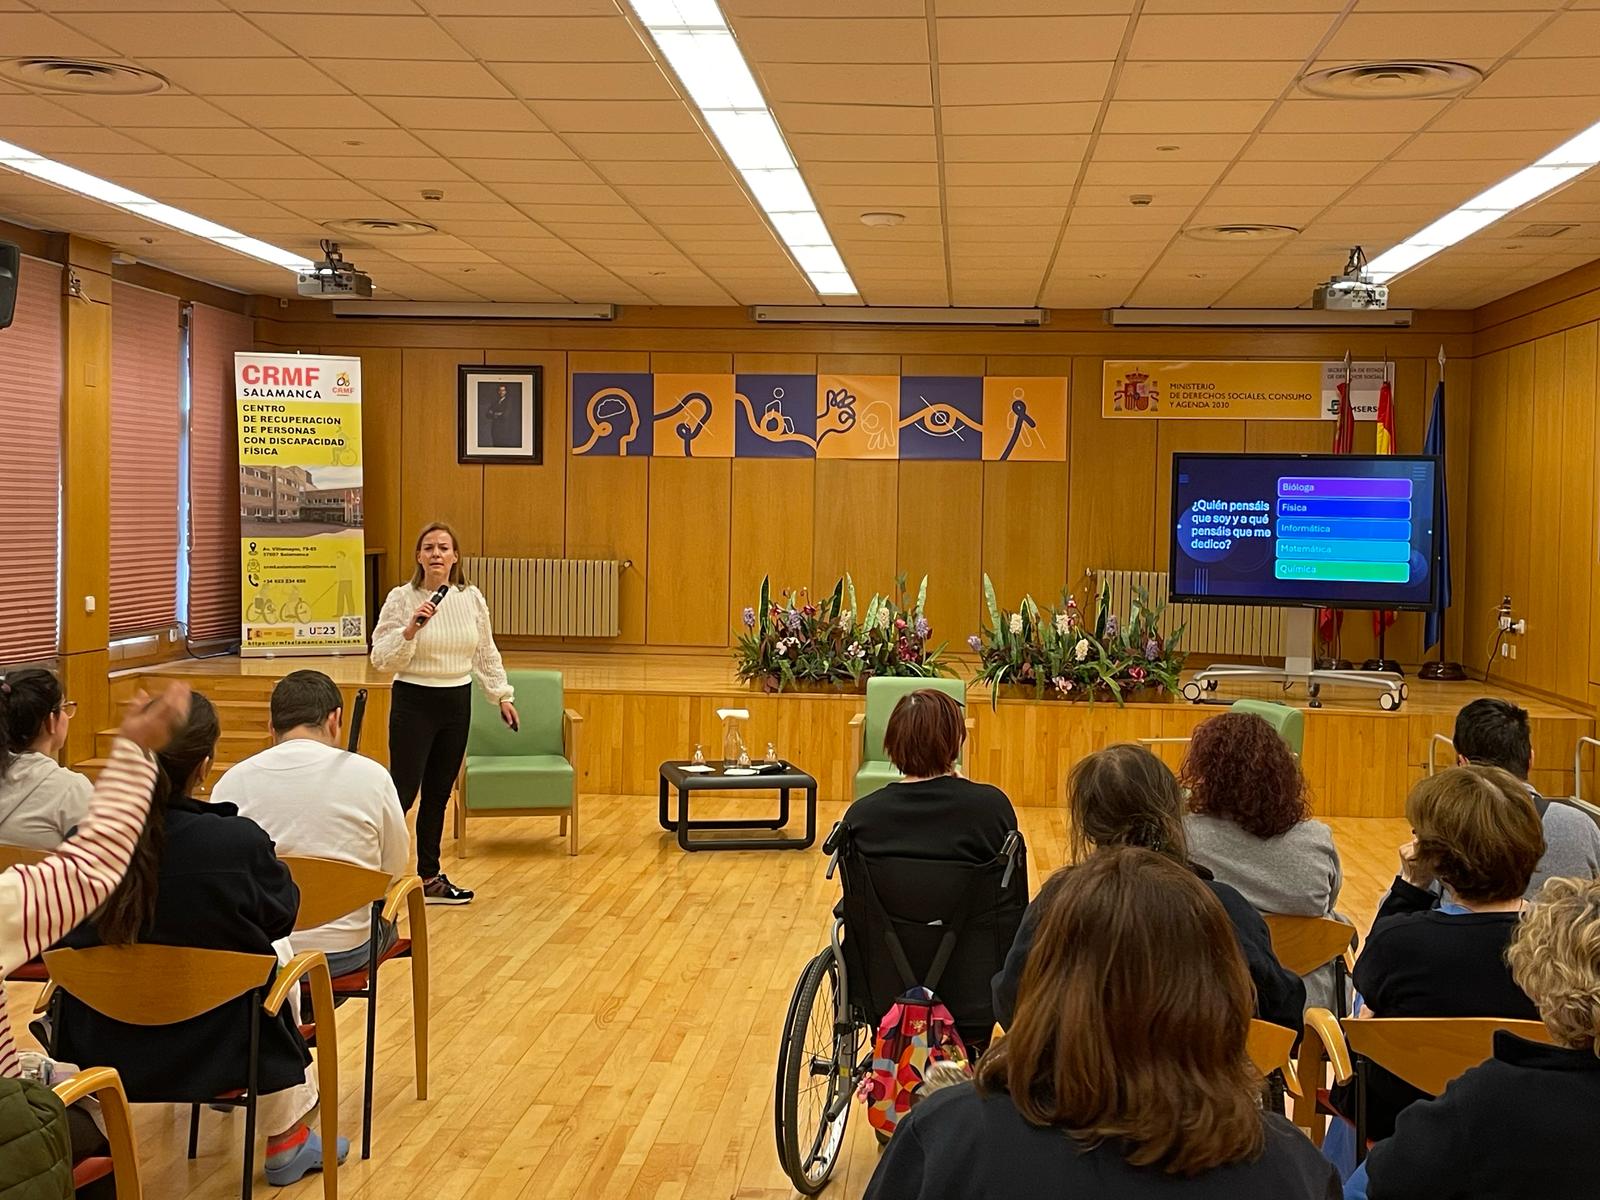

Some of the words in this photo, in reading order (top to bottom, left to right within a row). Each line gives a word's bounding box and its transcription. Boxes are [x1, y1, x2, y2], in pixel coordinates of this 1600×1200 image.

[242, 364, 320, 387] CRMF
[243, 388, 321, 399] SALAMANCA
[243, 404, 286, 413] CENTRO
[243, 415, 257, 423] DE
[260, 415, 341, 425] RECUPERACIÓN
[260, 426, 316, 435] PERSONAS
[269, 437, 345, 446] DISCAPACIDAD
[243, 446, 278, 455] FÍSICA
[1282, 482, 1315, 493] Bióloga
[1191, 499, 1228, 512] ¿Quién
[1229, 500, 1270, 512] pensáis
[1192, 514, 1212, 525] que
[1213, 514, 1231, 525] soy
[1232, 515, 1239, 526] y
[1240, 515, 1247, 524] a
[1248, 514, 1269, 526] qué
[1191, 526, 1231, 537] pensáis
[1232, 528, 1252, 539] que
[1254, 529, 1272, 537] me
[1281, 524, 1331, 533] Informática
[1191, 539, 1232, 550] dedico?
[1280, 544, 1332, 553] Matemática
[1280, 564, 1317, 574] Química
